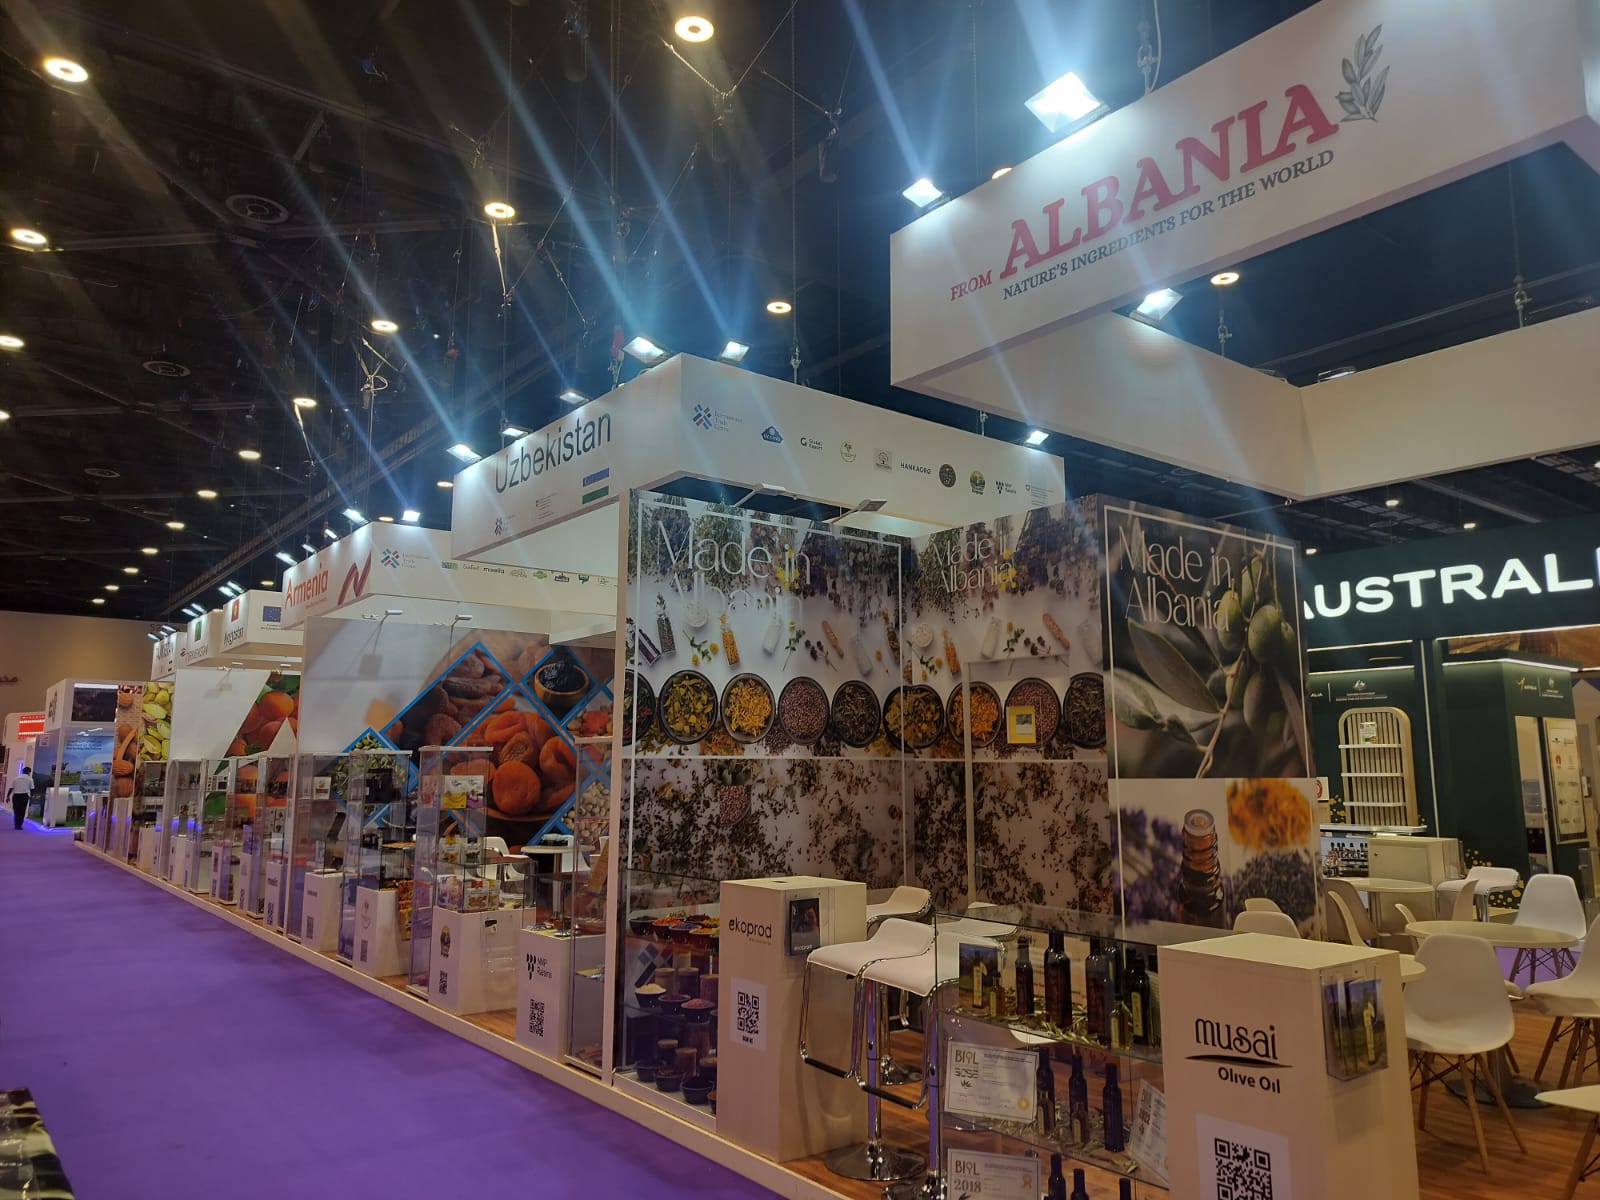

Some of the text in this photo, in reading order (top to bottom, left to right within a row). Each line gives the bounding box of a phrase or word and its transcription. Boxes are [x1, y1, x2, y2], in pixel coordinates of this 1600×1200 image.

[949, 83, 1339, 302] FROM ALBANIA
[1003, 149, 1335, 300] NATURE'S INGREDIENTS FOR THE WORLD
[495, 412, 612, 494] Uzbekistan
[657, 519, 811, 585] Made in
[932, 532, 993, 566] Made
[1119, 525, 1232, 588] Made in
[285, 562, 329, 610] Armenia
[936, 560, 1013, 594] Albania
[1124, 575, 1230, 632] Albania
[728, 916, 772, 939] ekoprod
[1195, 1018, 1279, 1060] musai
[954, 1179, 982, 1193] 2018
